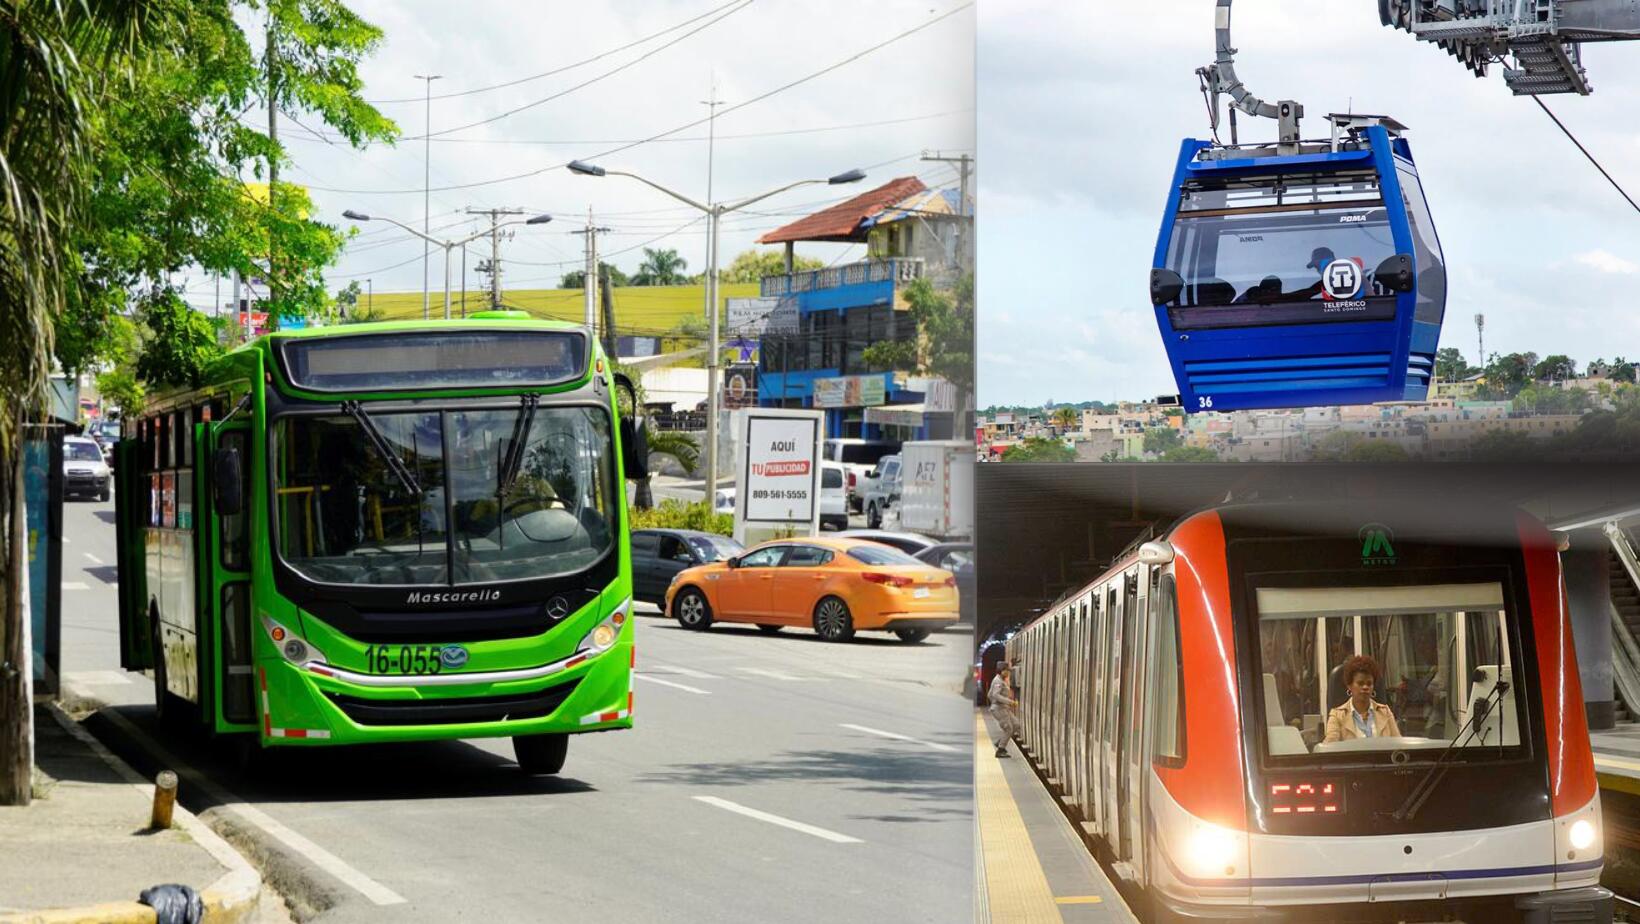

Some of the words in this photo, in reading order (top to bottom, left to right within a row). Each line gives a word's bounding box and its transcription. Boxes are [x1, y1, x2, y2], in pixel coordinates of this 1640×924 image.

[1323, 300, 1366, 308] TELEFÉRICO
[1199, 396, 1213, 408] 36
[770, 438, 796, 452] AQUÍ
[752, 464, 764, 475] TU
[765, 463, 806, 473] PUBLICIDAD
[752, 490, 807, 499] 809-561-5555
[407, 589, 501, 604] Mascarello
[364, 643, 442, 674] 16-055
